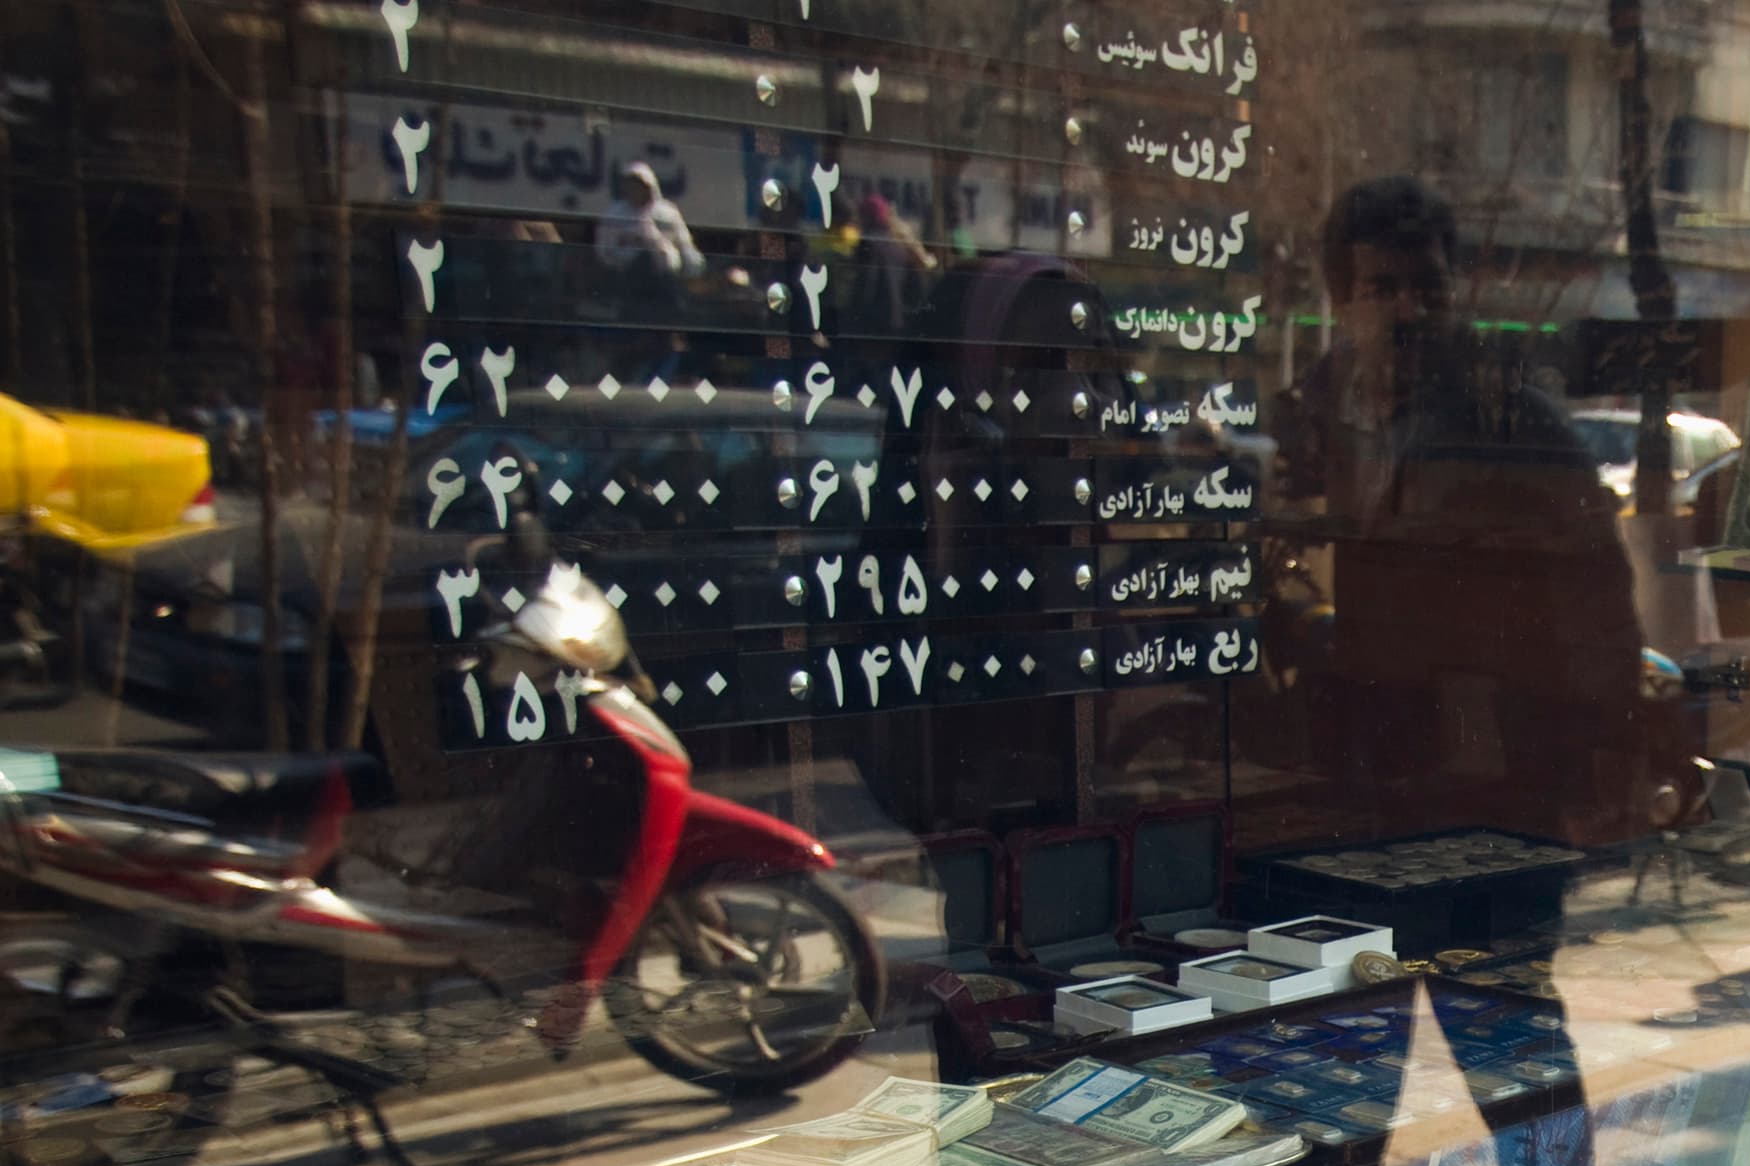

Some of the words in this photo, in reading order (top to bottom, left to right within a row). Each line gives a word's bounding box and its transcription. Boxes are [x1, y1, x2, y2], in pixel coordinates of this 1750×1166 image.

[1097, 31, 1157, 64] سوئیس
[1162, 26, 1258, 95] فرانک
[852, 65, 880, 132] ۲
[392, 117, 430, 194] ۲
[1126, 121, 1168, 164] سوئد
[1171, 125, 1252, 183] کرون
[812, 162, 839, 229] ۲
[1129, 216, 1164, 250] نروژ
[1170, 211, 1249, 270] کرون
[408, 240, 444, 313] ۲
[800, 264, 828, 331] ۲
[1114, 307, 1178, 338] دانمارک
[1178, 295, 1262, 352] کرون
[1100, 402, 1136, 431] امام
[1197, 383, 1257, 432] سکه
[1099, 482, 1153, 518] آزادی
[1154, 487, 1185, 517] بهار
[1193, 467, 1252, 510] سکه
[1111, 562, 1169, 601] آزادی
[1170, 565, 1200, 598] بهار
[1210, 545, 1252, 602] نیم
[1115, 636, 1166, 676] آزادی
[1166, 638, 1198, 670] بهار
[1208, 627, 1259, 675] ربع
